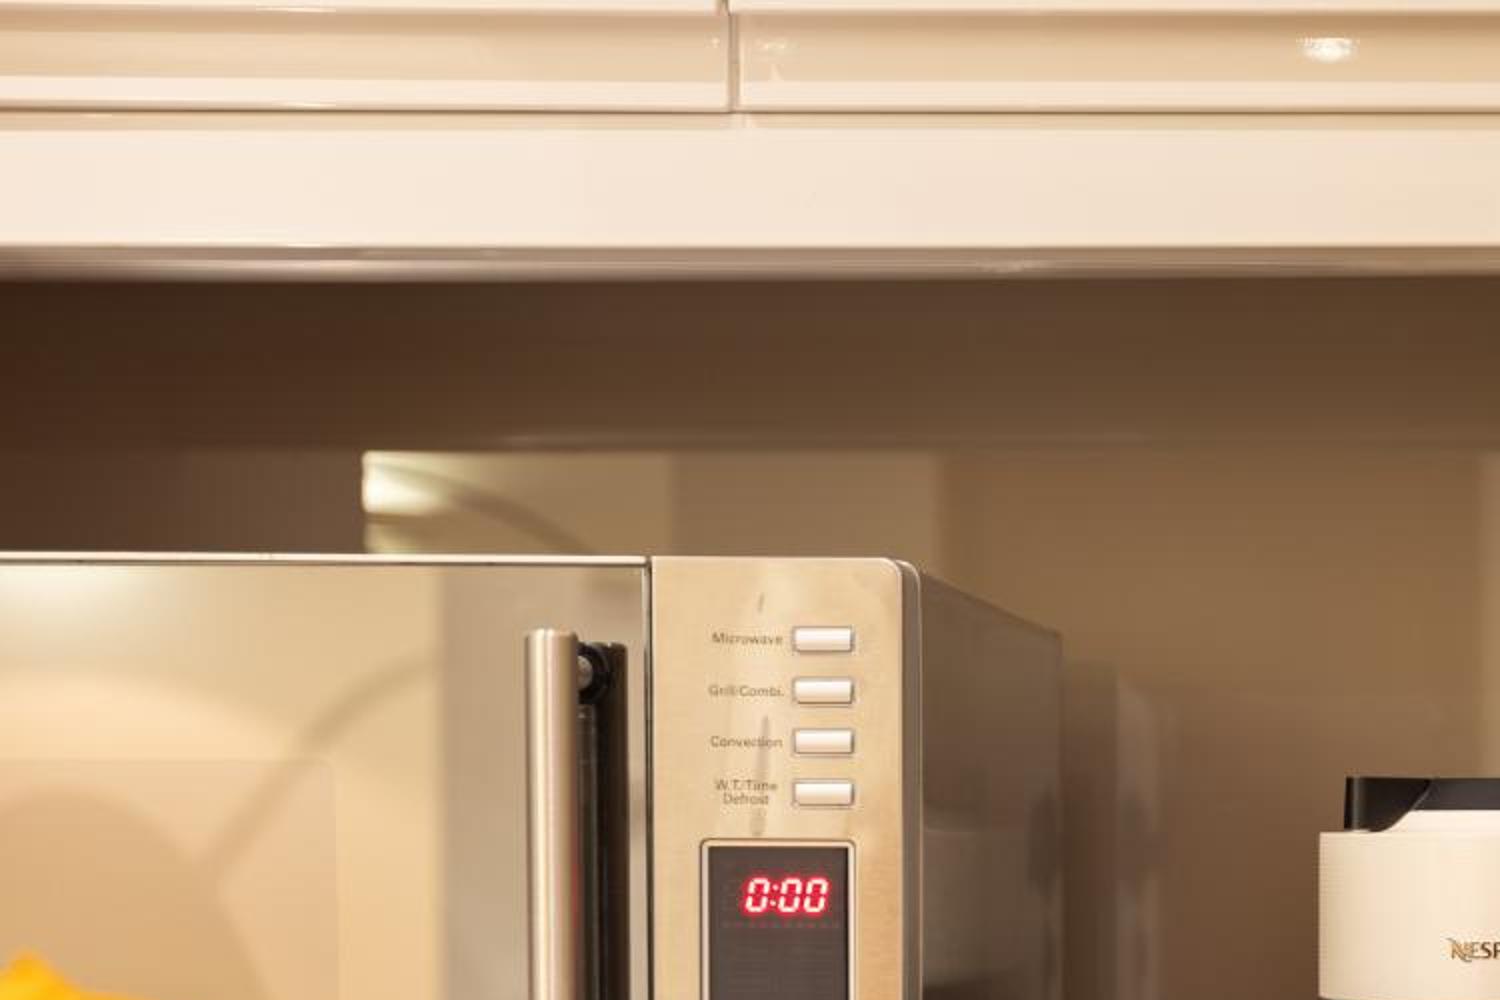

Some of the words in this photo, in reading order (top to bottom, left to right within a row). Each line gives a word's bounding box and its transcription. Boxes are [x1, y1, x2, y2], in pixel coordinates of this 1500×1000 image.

[711, 631, 783, 646] Microwave
[710, 735, 783, 748] Convection
[744, 877, 830, 913] 0:00
